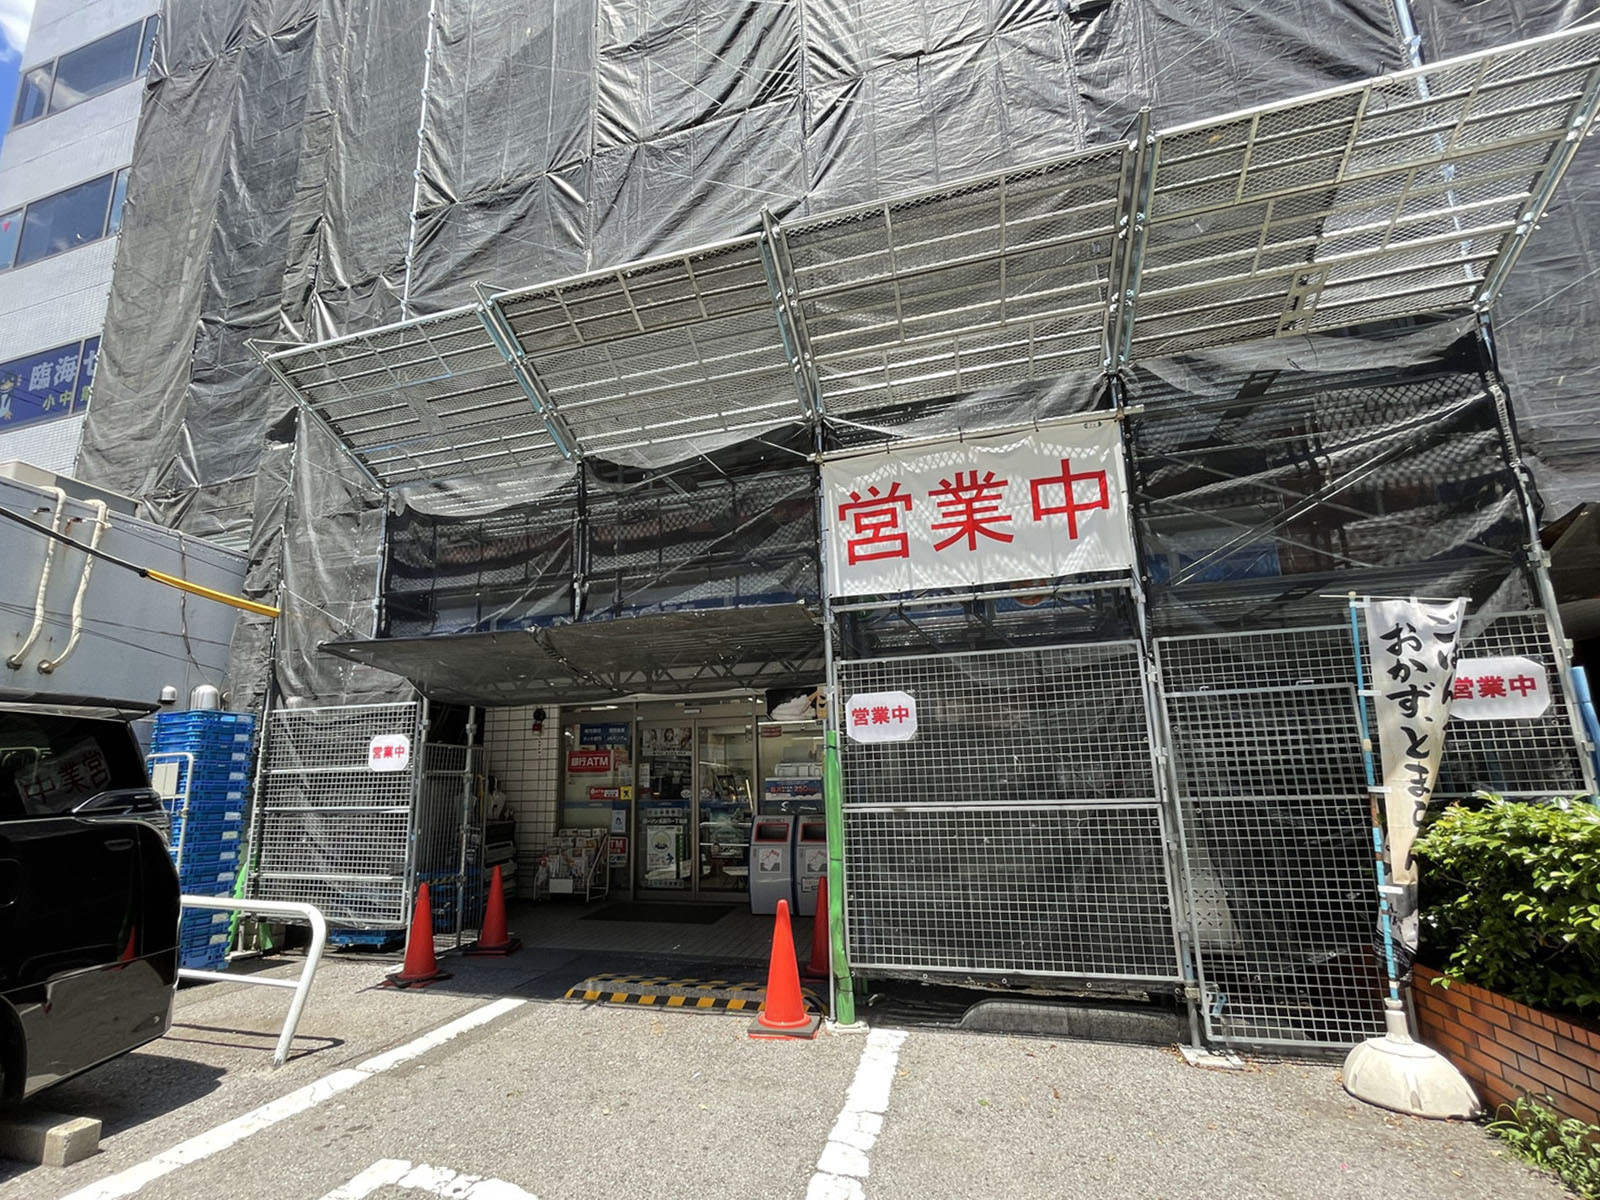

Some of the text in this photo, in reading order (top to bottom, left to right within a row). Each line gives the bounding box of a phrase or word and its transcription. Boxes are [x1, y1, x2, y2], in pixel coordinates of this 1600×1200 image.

[838, 458, 1110, 566] 営業中
[1452, 675, 1537, 700] 営業中
[852, 705, 910, 726] 営業中
[372, 745, 405, 760] 営業中
[609, 839, 624, 849] TM
